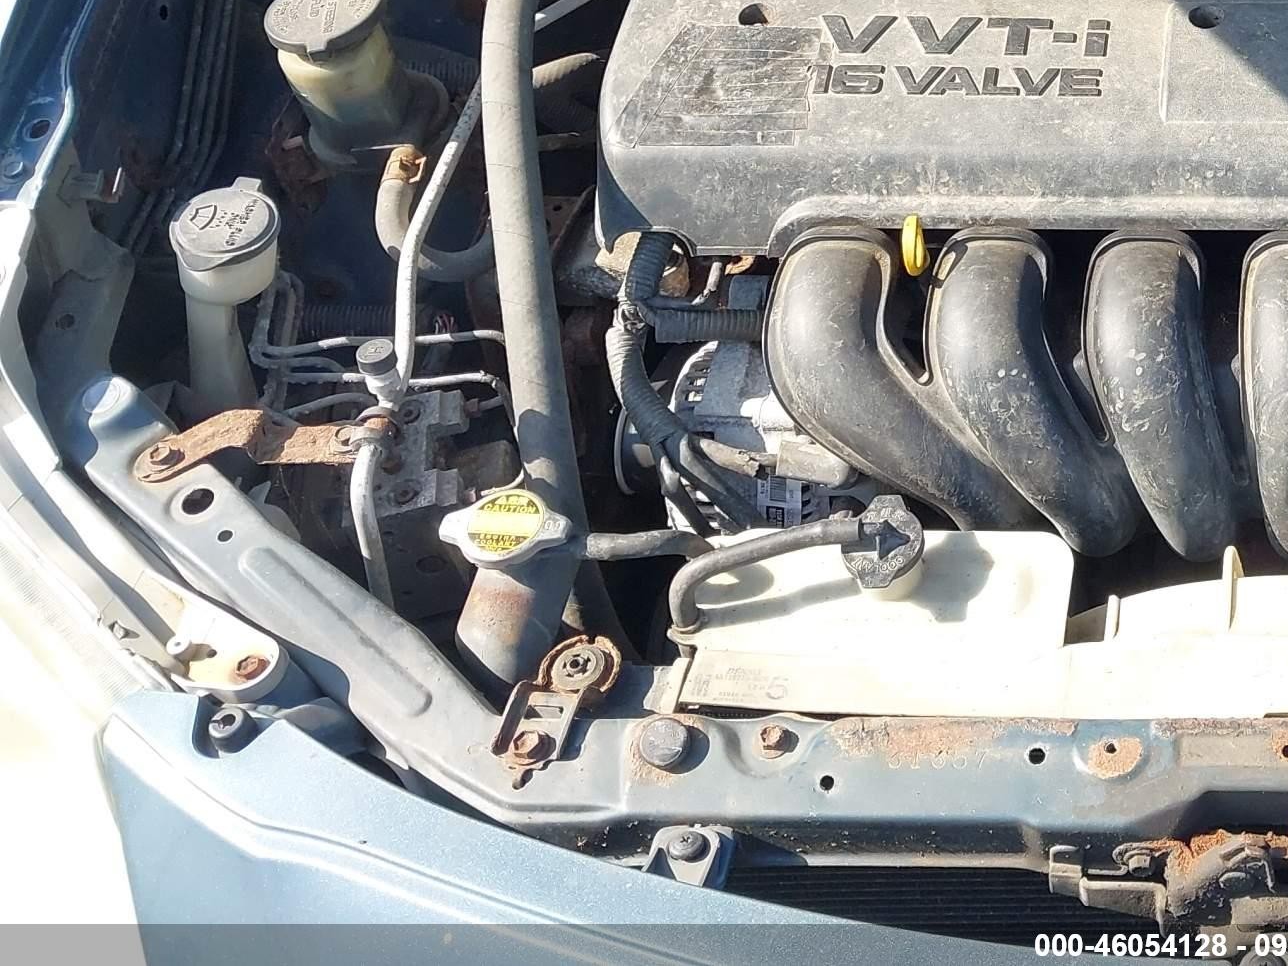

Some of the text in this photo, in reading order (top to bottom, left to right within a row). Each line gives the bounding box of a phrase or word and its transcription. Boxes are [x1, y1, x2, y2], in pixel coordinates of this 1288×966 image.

[820, 14, 1111, 58] VVT-i
[808, 64, 1103, 97] 16 VALVE
[484, 504, 536, 514] CAUTION
[474, 539, 518, 548] COOLANT
